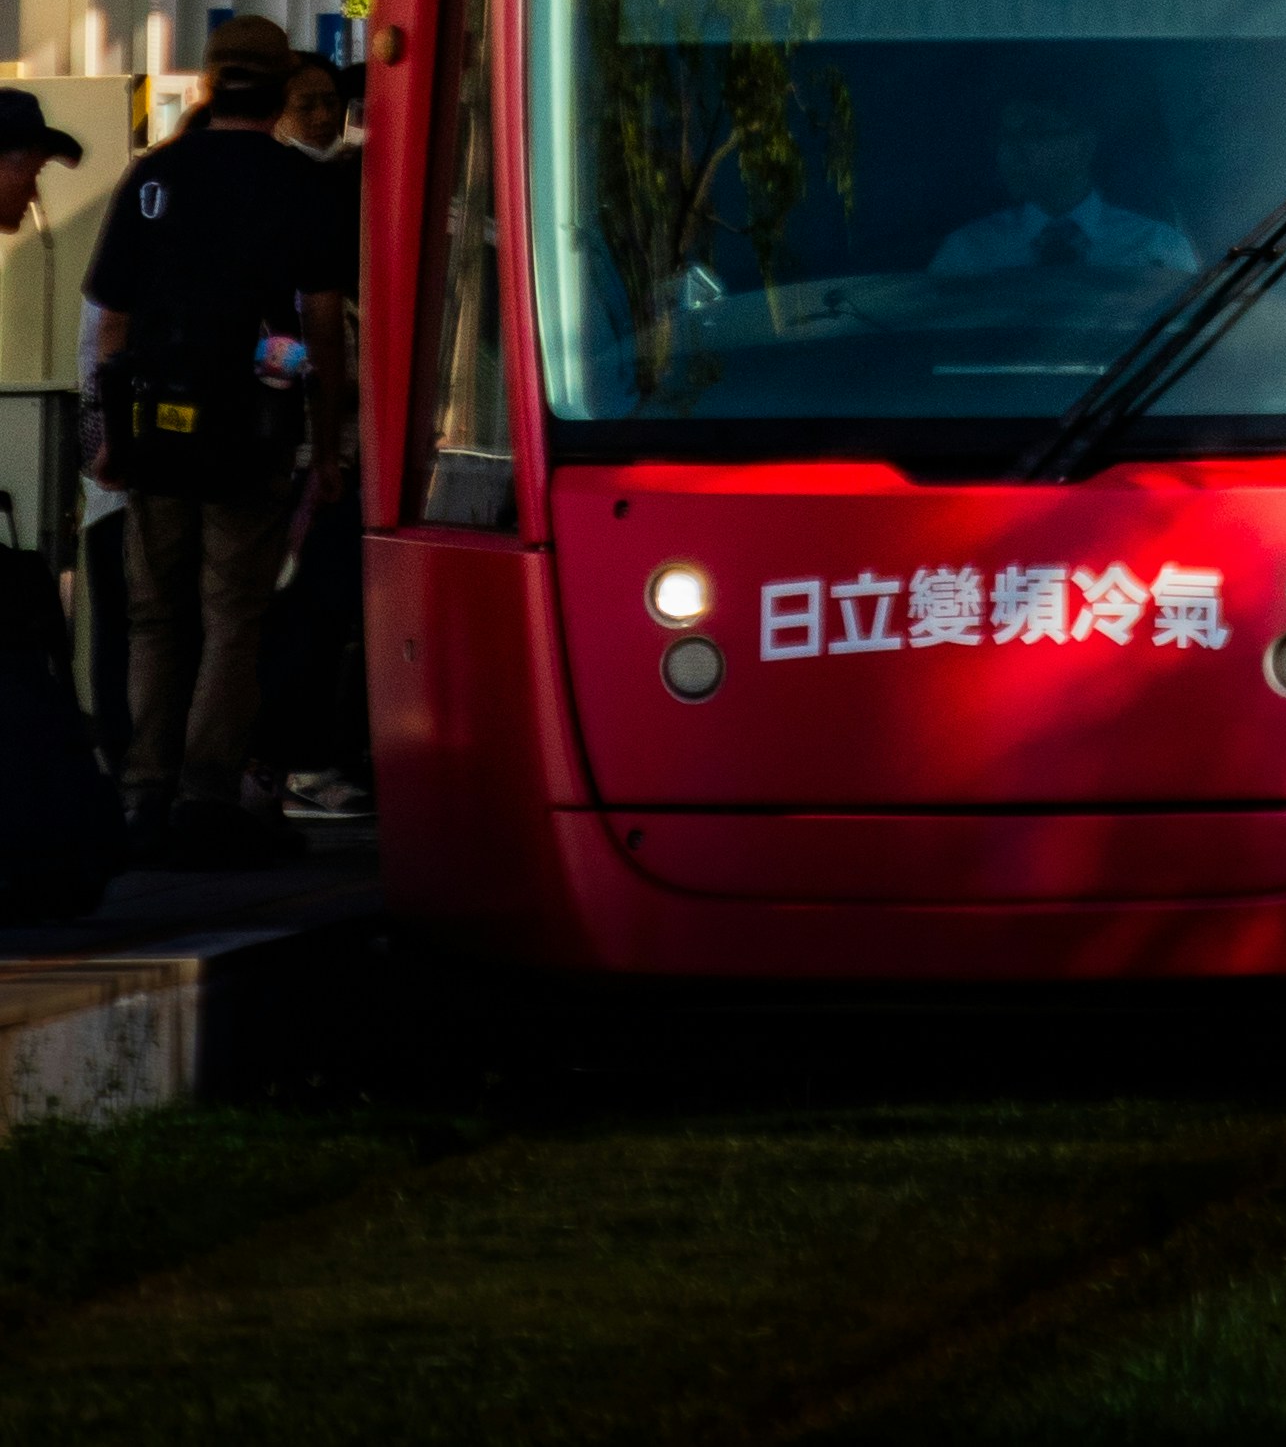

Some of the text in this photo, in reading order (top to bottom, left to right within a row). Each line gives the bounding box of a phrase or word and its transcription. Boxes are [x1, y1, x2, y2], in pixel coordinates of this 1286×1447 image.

[760, 565, 1229, 662] 日立變頻冷氣
